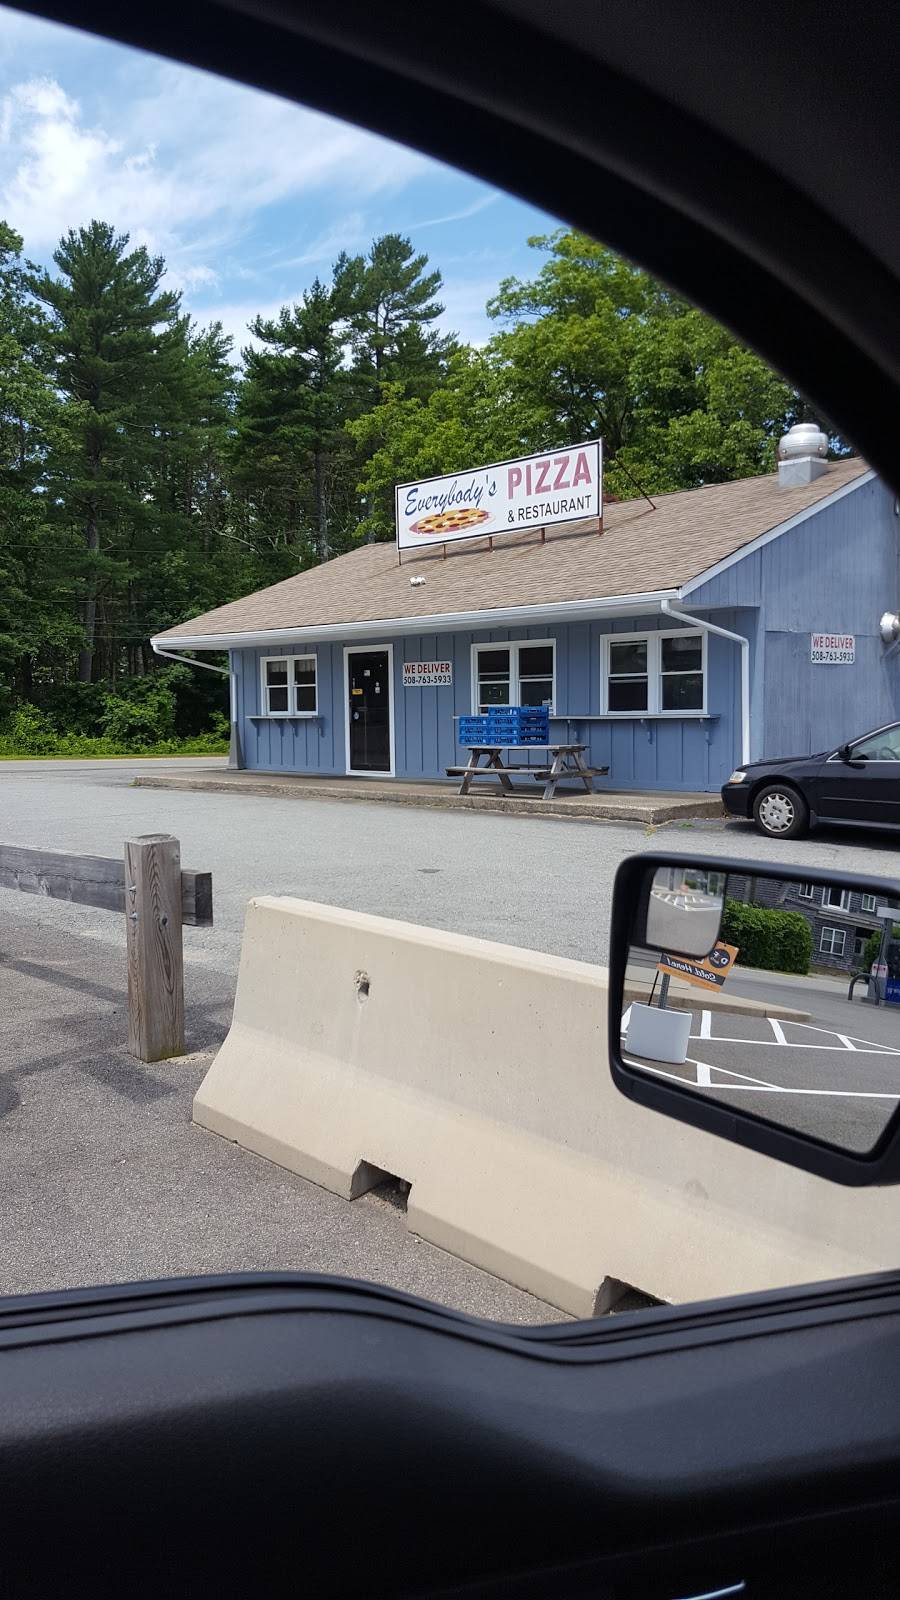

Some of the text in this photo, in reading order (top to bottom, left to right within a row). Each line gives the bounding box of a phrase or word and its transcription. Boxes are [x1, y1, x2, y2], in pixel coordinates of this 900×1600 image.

[405, 452, 592, 516] Everybody's PIZZA
[507, 495, 592, 523] & RESTAURANT
[813, 636, 853, 649] WE DELIVER
[811, 650, 854, 662] 508-763-5933
[404, 663, 450, 674] WE DELIVER
[403, 675, 451, 684] 508-763-5933
